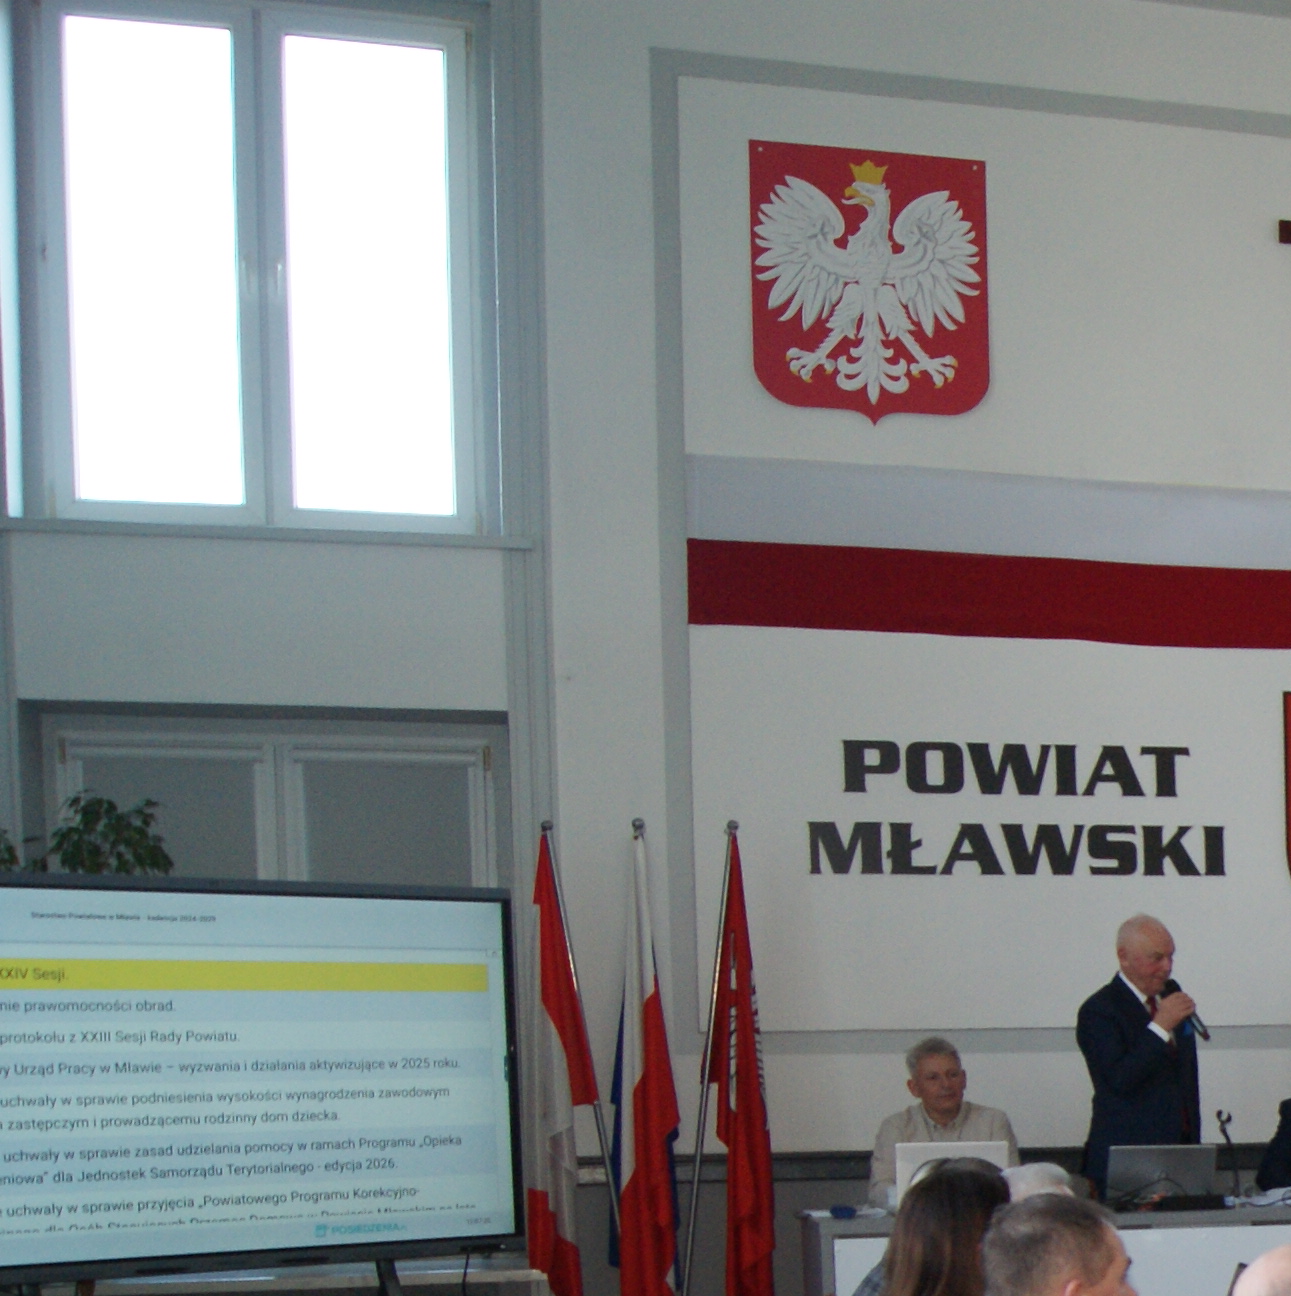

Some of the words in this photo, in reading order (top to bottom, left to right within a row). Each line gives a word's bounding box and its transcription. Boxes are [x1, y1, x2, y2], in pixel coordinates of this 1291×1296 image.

[842, 739, 1190, 798] POWIAT
[807, 820, 1226, 876] MŁAWSKI
[32, 967, 70, 984] Sesji.
[23, 999, 132, 1014] prawomocności
[135, 999, 177, 1012] obrad.
[0, 1031, 66, 1046] protokołu
[68, 1033, 77, 1043] z
[81, 1031, 111, 1043] XXIII
[114, 1030, 147, 1046] Sesji
[149, 1030, 182, 1045] Rady
[185, 1030, 240, 1042] Powiatu.
[13, 1062, 55, 1078] Urząd
[57, 1062, 96, 1077] Pracy
[99, 1065, 111, 1074] w
[114, 1061, 162, 1074] Mławie
[178, 1062, 241, 1075] wyzwania
[250, 1059, 306, 1072] działania
[309, 1059, 385, 1073] aktywizujące
[388, 1061, 398, 1069] w
[401, 1057, 431, 1070] 2025
[432, 1057, 462, 1069] roku.
[60, 1097, 72, 1106] w
[75, 1095, 128, 1108] sprawie
[131, 1092, 214, 1107] podniesienia
[216, 1089, 282, 1105] wysokości
[285, 1088, 376, 1103] wynagrodzenia
[378, 1086, 450, 1100] zawodowym
[7, 1118, 90, 1132] zastępczym
[100, 1114, 201, 1130] prowadzącemu
[203, 1112, 258, 1126] rodzinny
[260, 1111, 289, 1123] dom
[291, 1109, 341, 1122] dziecka.
[3, 1149, 60, 1164] uchwały
[63, 1151, 75, 1160] w
[79, 1148, 131, 1162] sprawie
[134, 1144, 174, 1158] zasad
[176, 1143, 241, 1156] udzielania
[243, 1141, 294, 1157] pomocy
[297, 1142, 308, 1151] w
[310, 1138, 356, 1151] ramach
[358, 1137, 416, 1152] Programu
[418, 1135, 463, 1149] „Opieka
[52, 1171, 74, 1183] dla
[77, 1167, 146, 1182] Jednostek
[149, 1164, 223, 1180] Samorządu
[226, 1162, 315, 1178] Terytorialnego
[323, 1159, 363, 1174] edycja
[365, 1157, 399, 1170] 2026.
[6, 1203, 63, 1218] uchwały
[66, 1205, 78, 1214] w
[81, 1202, 134, 1216] sprawie
[137, 1198, 195, 1213] przyjęcia
[198, 1194, 288, 1209] „Powiatowego
[290, 1190, 350, 1205] Programu
[352, 1185, 420, 1203] Korekcyjno-
